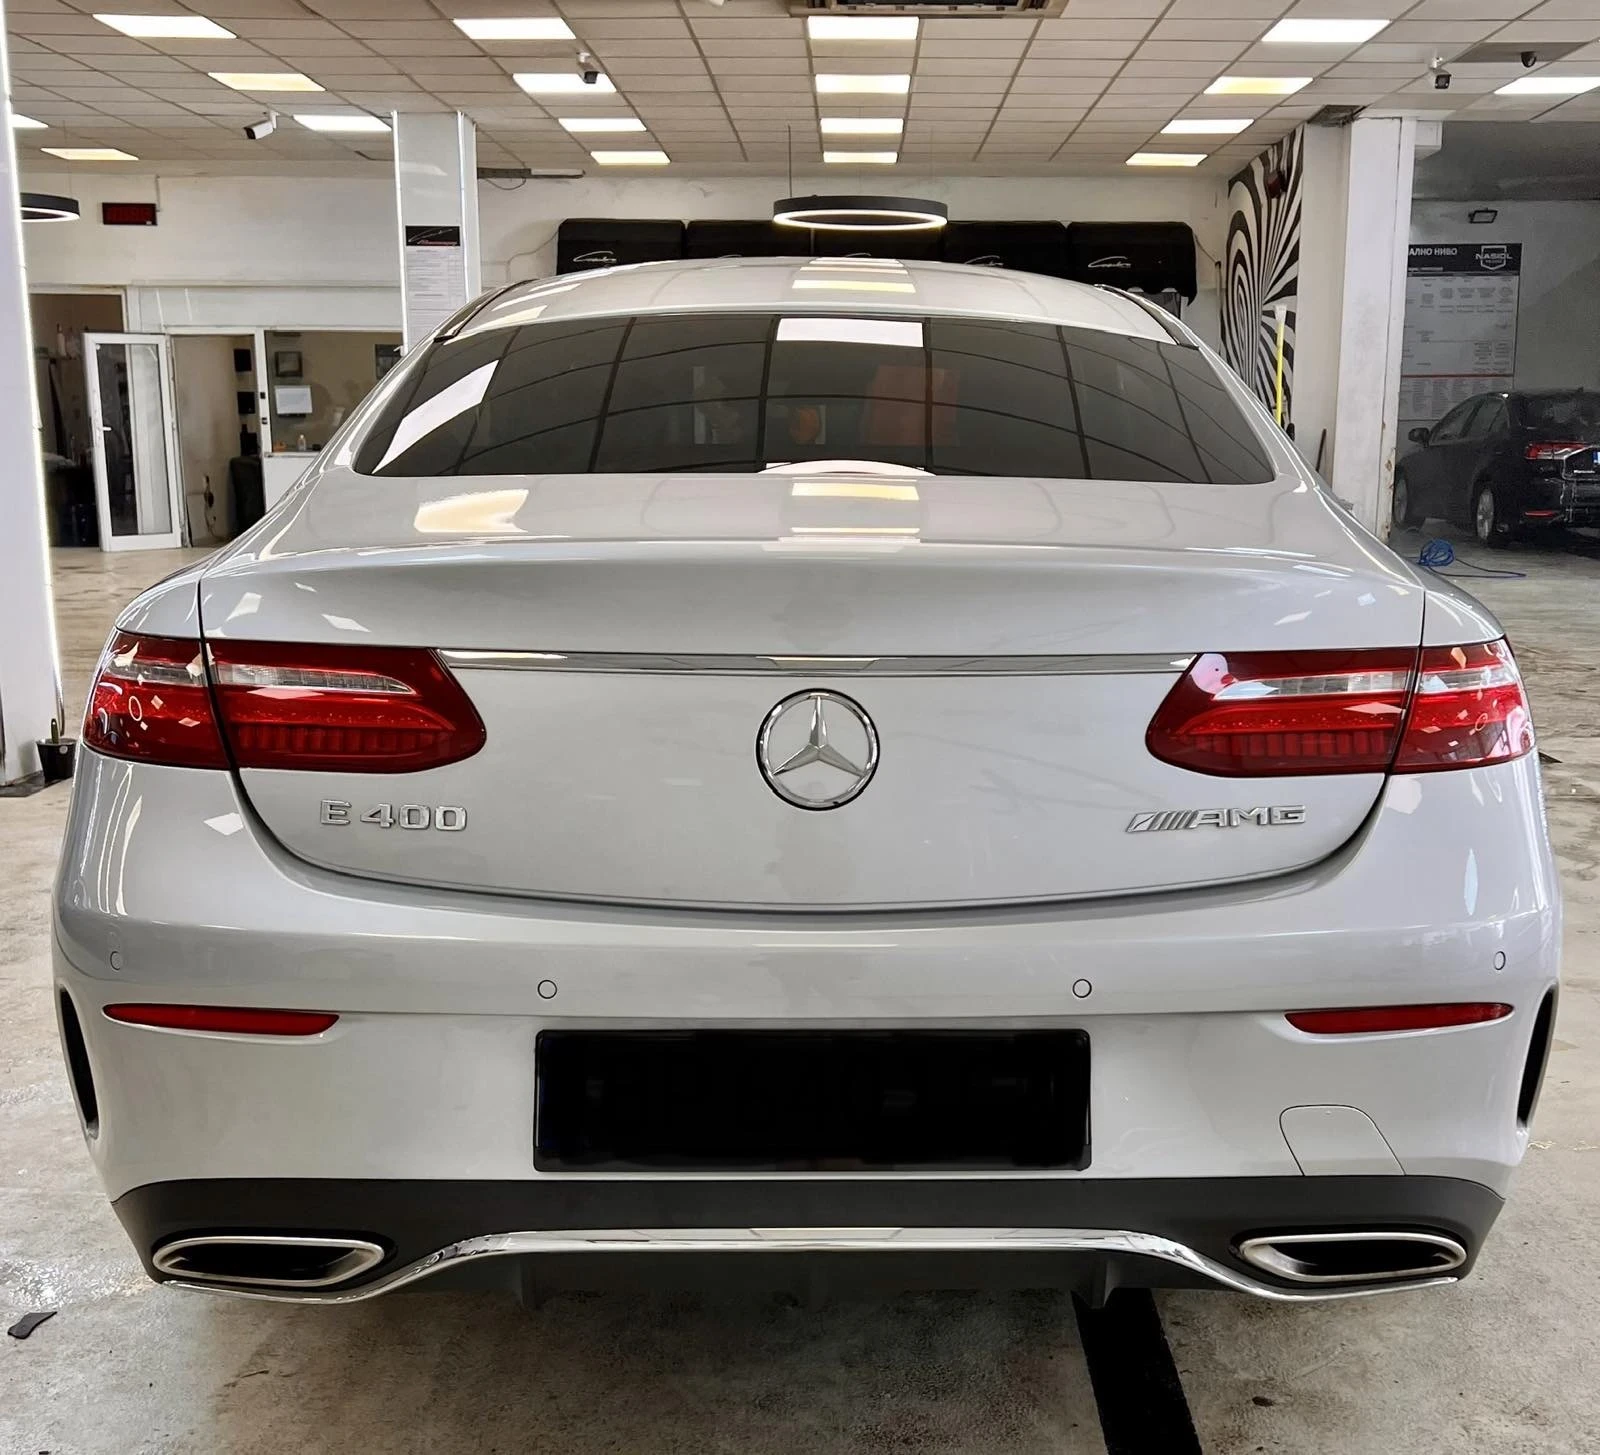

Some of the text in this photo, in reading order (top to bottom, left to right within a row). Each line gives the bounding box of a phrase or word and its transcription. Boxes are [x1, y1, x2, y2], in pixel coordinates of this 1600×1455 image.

[1434, 248, 1457, 256] НИВО
[320, 799, 468, 831] E 400
